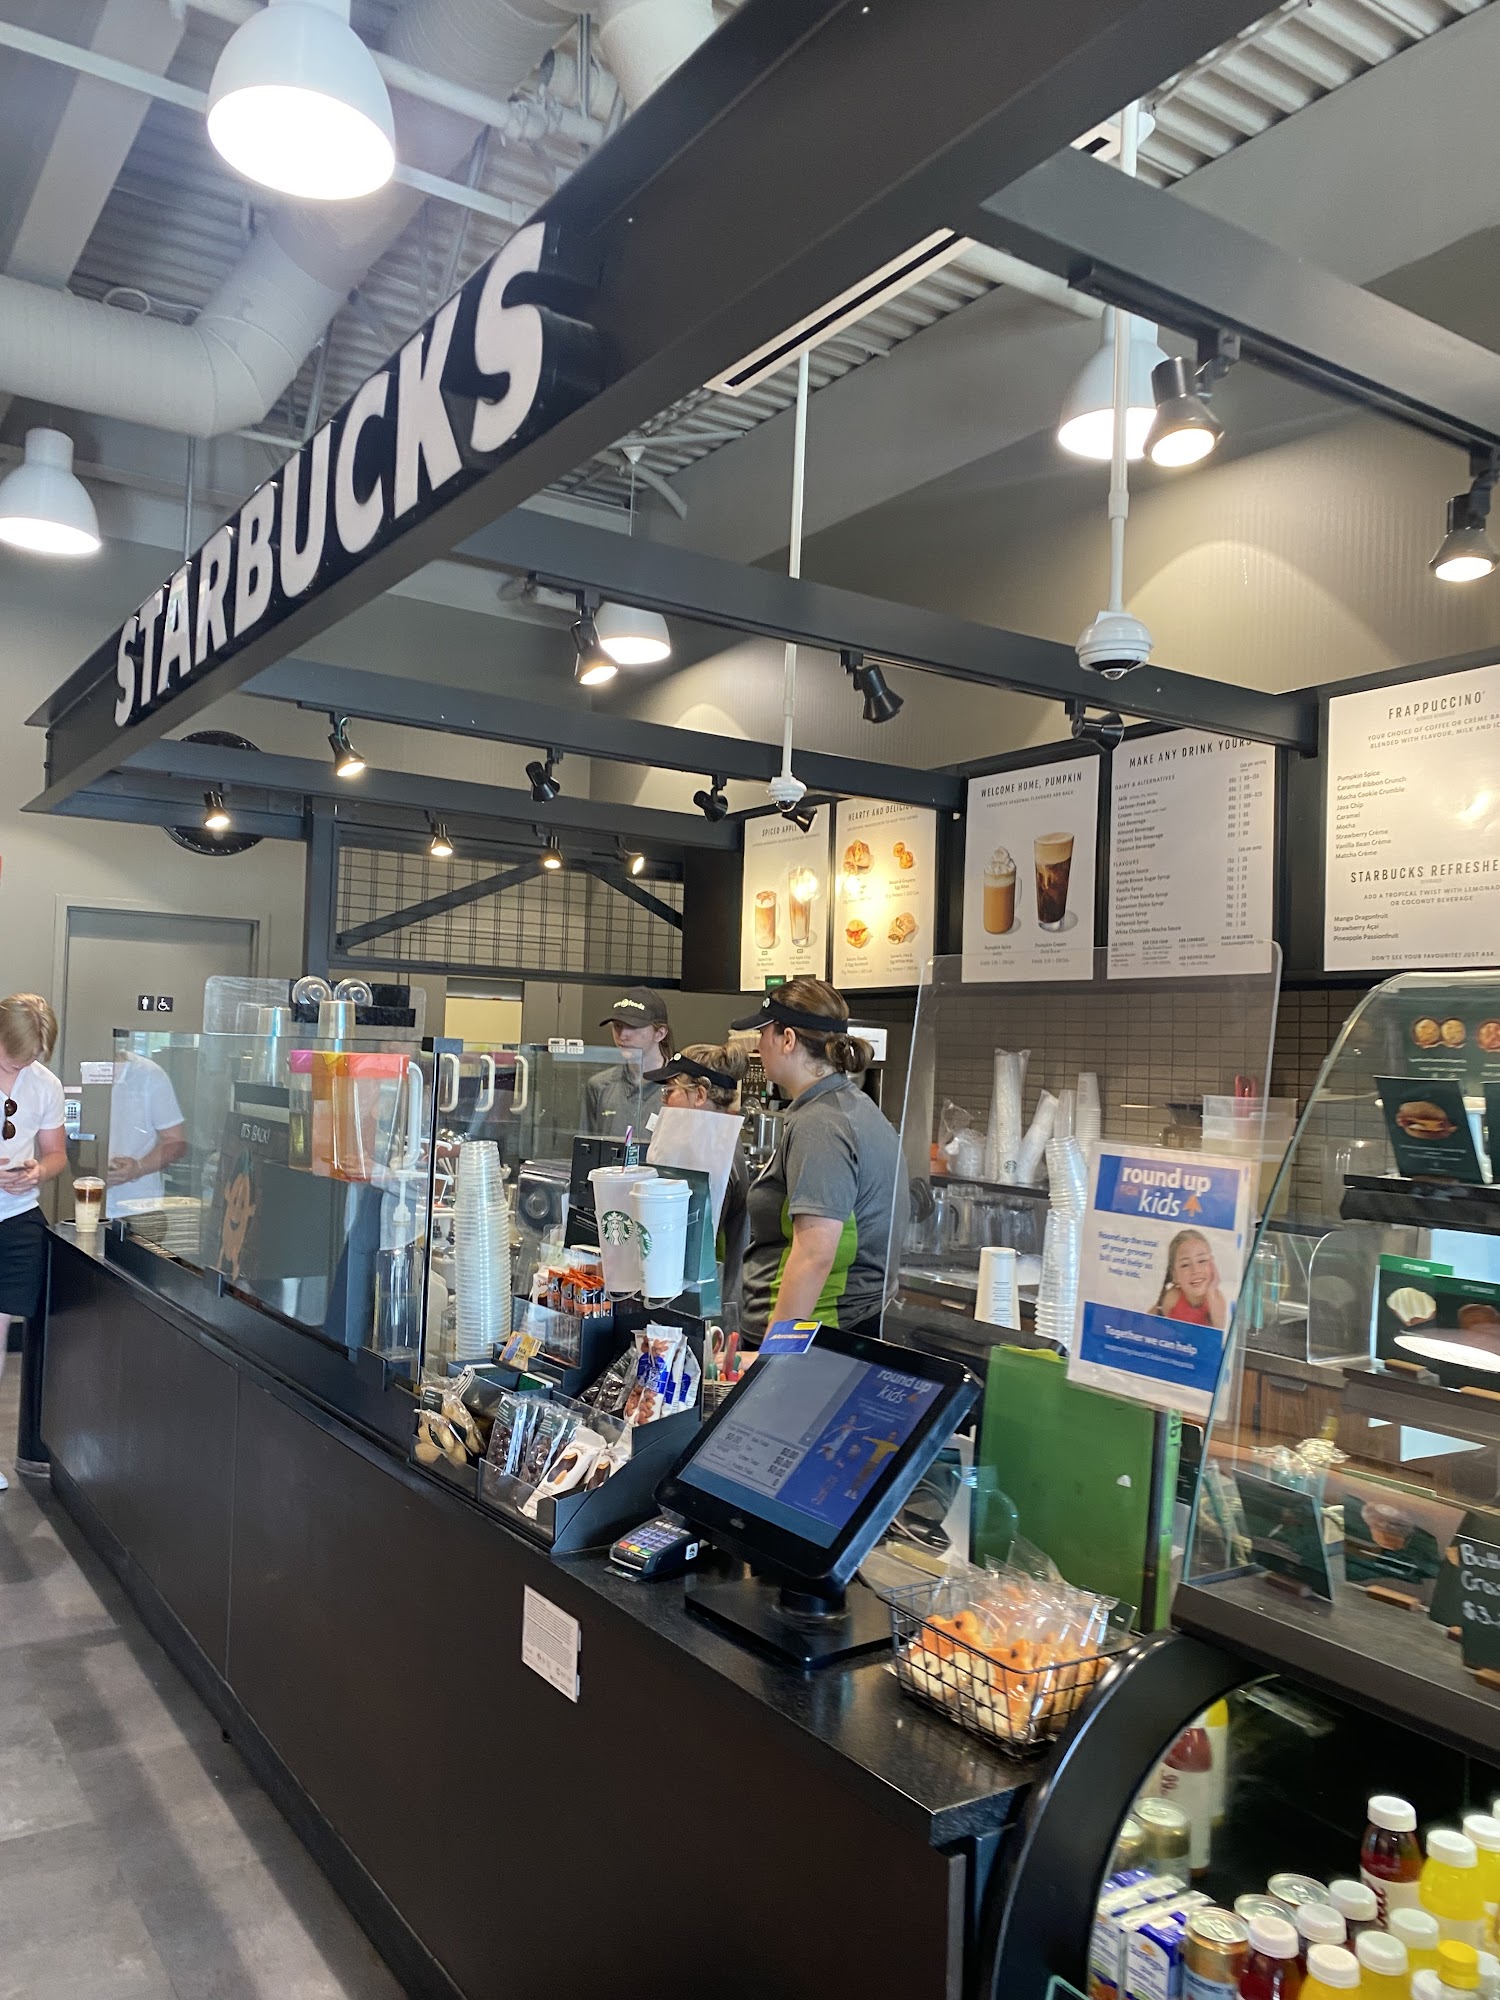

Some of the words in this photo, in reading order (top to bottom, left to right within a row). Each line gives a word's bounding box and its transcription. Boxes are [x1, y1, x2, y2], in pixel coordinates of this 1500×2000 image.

[114, 221, 546, 727] STARBUCKS
[1389, 691, 1482, 719] FRAPPUCCINO
[1368, 732, 1385, 741] YOUR
[1387, 728, 1412, 738] CHOICE
[1425, 722, 1450, 731] COFFEE
[1464, 715, 1488, 724] CRÈME
[1129, 754, 1154, 768] MAKE
[1158, 749, 1177, 762] ANY
[1182, 742, 1213, 758] DRINK
[1370, 740, 1398, 749] BLENDED
[981, 784, 1015, 798] WELCOME
[1018, 780, 1041, 791] HOME,
[1045, 772, 1082, 787] PUMPKIN
[1337, 782, 1361, 791] Caramel
[1338, 773, 1362, 781] Pumpkin
[1379, 787, 1405, 795] Crumble
[1336, 812, 1360, 820] Caramel
[1350, 866, 1424, 883] STARBUCKS
[1354, 913, 1388, 921] Dragonfruit
[1122, 1167, 1182, 1188] round
[1183, 1174, 1211, 1197] up
[1138, 1188, 1181, 1216] kids
[1104, 1324, 1143, 1342] Together
[1160, 1340, 1176, 1349] can
[1176, 1341, 1198, 1356] help
[877, 1370, 917, 1387] round
[913, 1380, 933, 1394] up
[877, 1384, 906, 1403] kids
